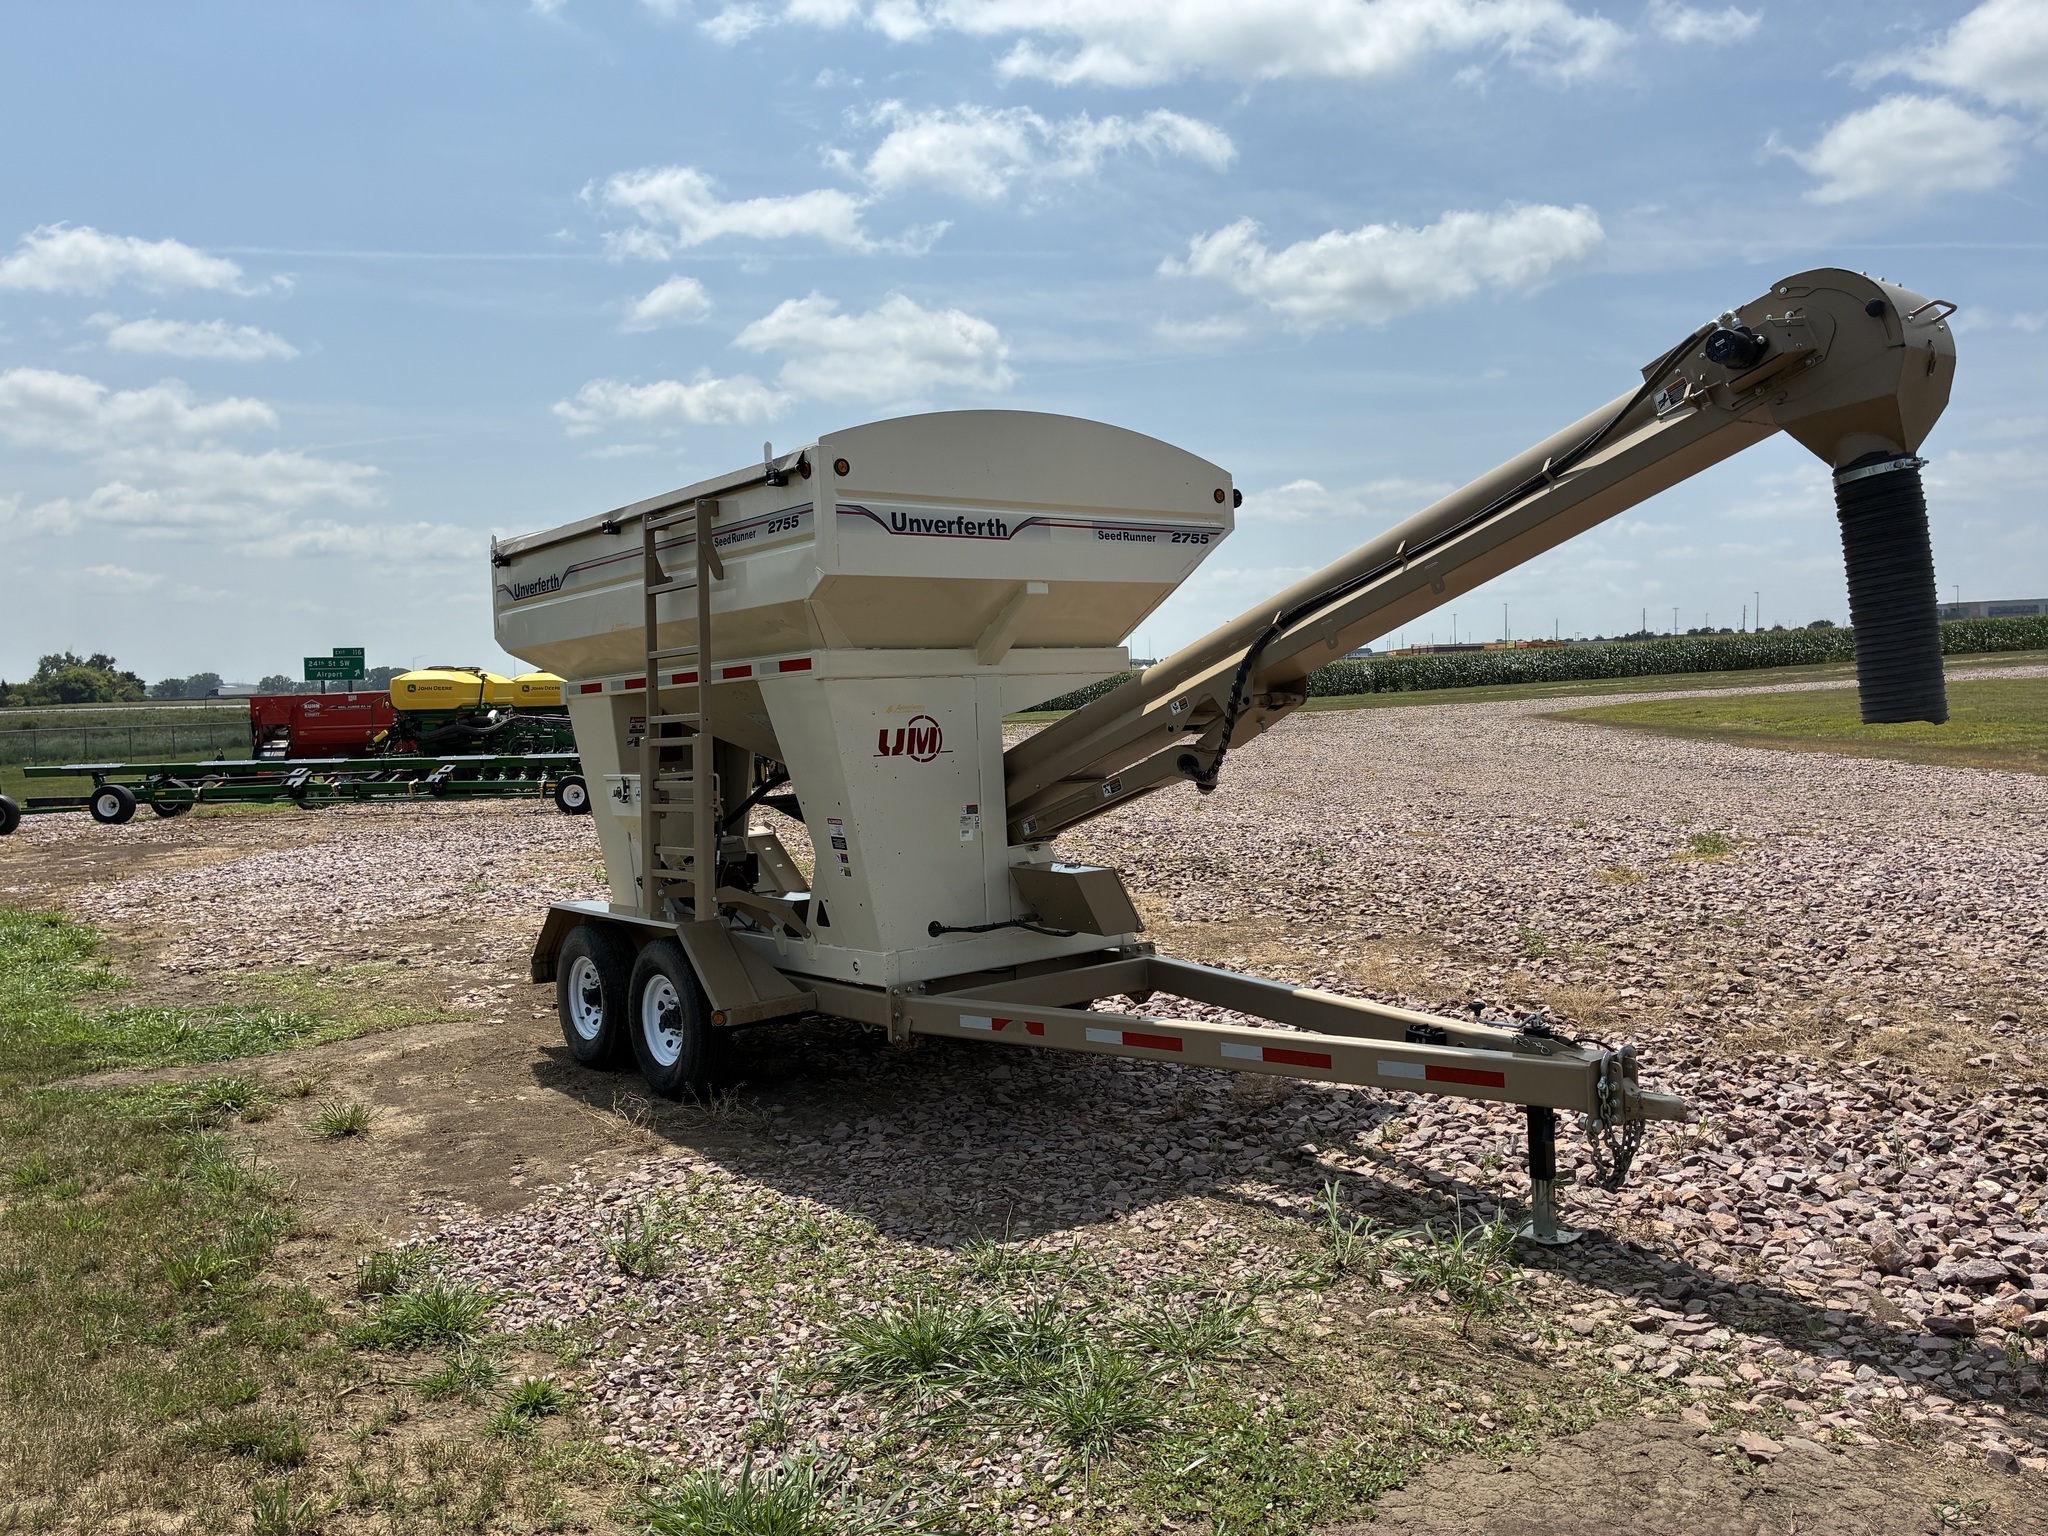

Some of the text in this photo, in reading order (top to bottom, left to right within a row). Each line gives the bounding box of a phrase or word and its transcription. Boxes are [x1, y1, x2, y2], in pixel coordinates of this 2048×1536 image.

[767, 514, 800, 535] 2755
[890, 511, 1009, 537] Unverferth
[1170, 532, 1210, 545] 2755
[513, 573, 560, 598] Unverferth
